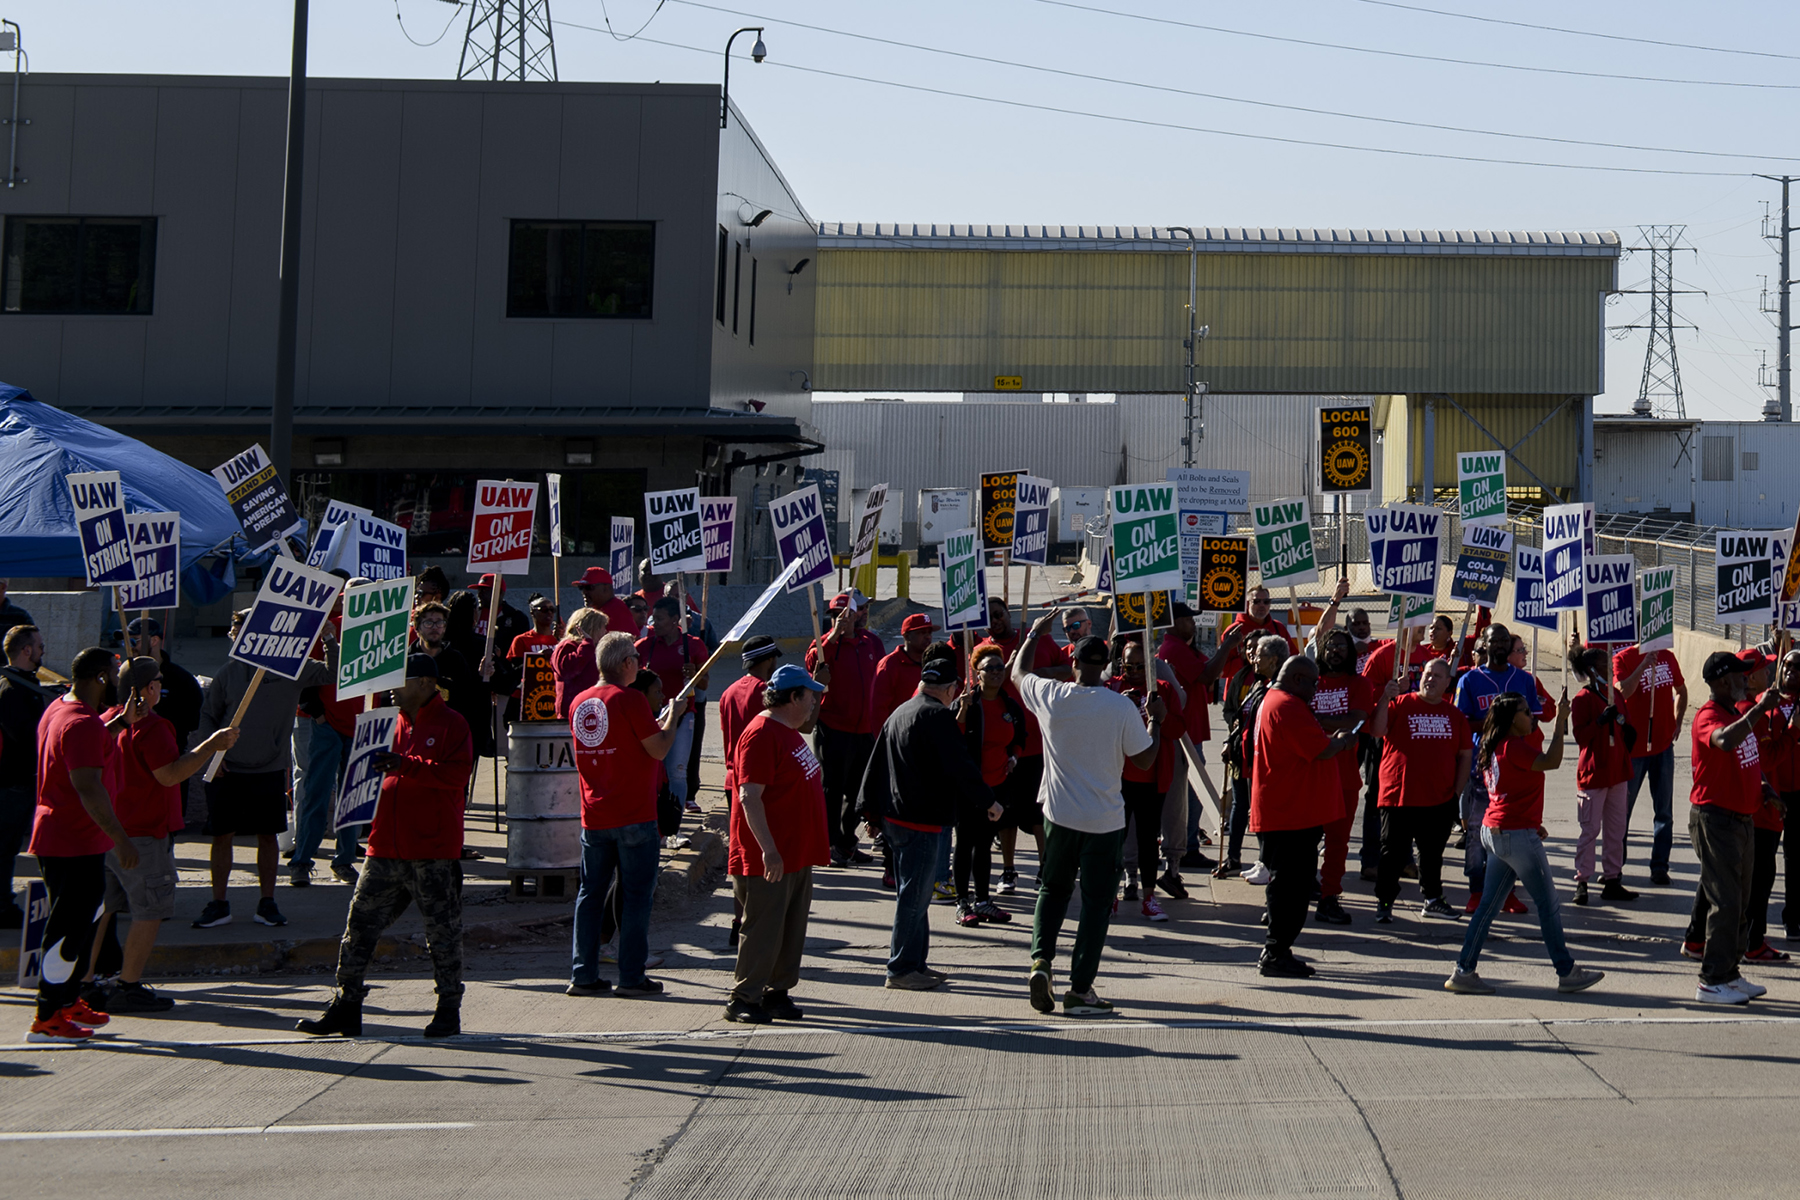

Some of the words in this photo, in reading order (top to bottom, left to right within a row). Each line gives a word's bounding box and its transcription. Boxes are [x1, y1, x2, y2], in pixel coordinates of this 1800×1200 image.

[1321, 410, 1369, 423] LOCAL
[1332, 426, 1359, 437] 600
[222, 449, 262, 484] UAW
[1461, 456, 1501, 474] UAW
[231, 479, 259, 502] STAND
[261, 468, 273, 481] UP
[983, 475, 1017, 488] LOCA
[1472, 478, 1490, 497] ON
[72, 482, 117, 510] UAW
[242, 485, 276, 513] SAVING
[480, 486, 534, 508] UAW
[650, 493, 696, 515] UAW
[993, 489, 1017, 501] 600
[1018, 482, 1050, 507] UAW
[1115, 487, 1174, 514] UAW
[1189, 497, 1218, 506] dropping
[1462, 488, 1505, 519] STRIKE
[242, 493, 289, 528] AMERICAN
[252, 506, 286, 533] DREAM
[774, 493, 817, 529] UAW
[1026, 512, 1039, 532] ON
[1256, 502, 1303, 526] UAW
[1389, 510, 1438, 535] UAW
[95, 518, 113, 547] ON
[360, 519, 403, 547] UAW
[490, 514, 513, 538] ON
[663, 518, 683, 541] ON
[1131, 520, 1156, 548] ON
[1472, 527, 1506, 548] UAW
[1546, 514, 1580, 540] UAW
[472, 529, 532, 561] STRIKE
[652, 529, 701, 565] STRIKE
[795, 527, 812, 554] ON
[947, 534, 974, 558] UAW
[1015, 530, 1046, 556] STRIKE
[1203, 540, 1247, 551] LOCAL
[1272, 529, 1293, 553] ON
[1402, 541, 1421, 563] ON
[1721, 537, 1768, 557] UAW
[89, 539, 130, 579] STRIKE
[373, 548, 391, 564] ON
[1116, 534, 1178, 579] STRIKE
[1212, 554, 1237, 564] 600
[1261, 540, 1312, 580] STRIKE
[1463, 548, 1492, 559] STAND
[1493, 552, 1506, 560] UP
[1467, 561, 1494, 572] COLA
[1556, 547, 1570, 575] ON
[954, 562, 967, 587] ON
[1386, 560, 1434, 587] STRIKE
[1456, 570, 1479, 581] FAIR
[1480, 574, 1501, 584] PAY
[1547, 566, 1581, 605] STRIKE
[1586, 562, 1631, 584] UAW
[1644, 568, 1673, 593] UAW
[1732, 563, 1753, 587] ON
[269, 566, 335, 608] UAW
[1463, 581, 1488, 591] NOW
[1718, 577, 1771, 613] STRIKE
[348, 586, 408, 619] UAW
[1602, 591, 1618, 614] ON
[1649, 595, 1663, 617] ON
[271, 610, 302, 633] ON
[1591, 611, 1632, 642] STRIKE
[1641, 606, 1673, 645] STRIKE
[239, 633, 310, 659] STRIKE
[359, 621, 386, 651] ON
[340, 633, 406, 688] STRIKE
[355, 717, 393, 750] UAW
[352, 755, 370, 787] ON
